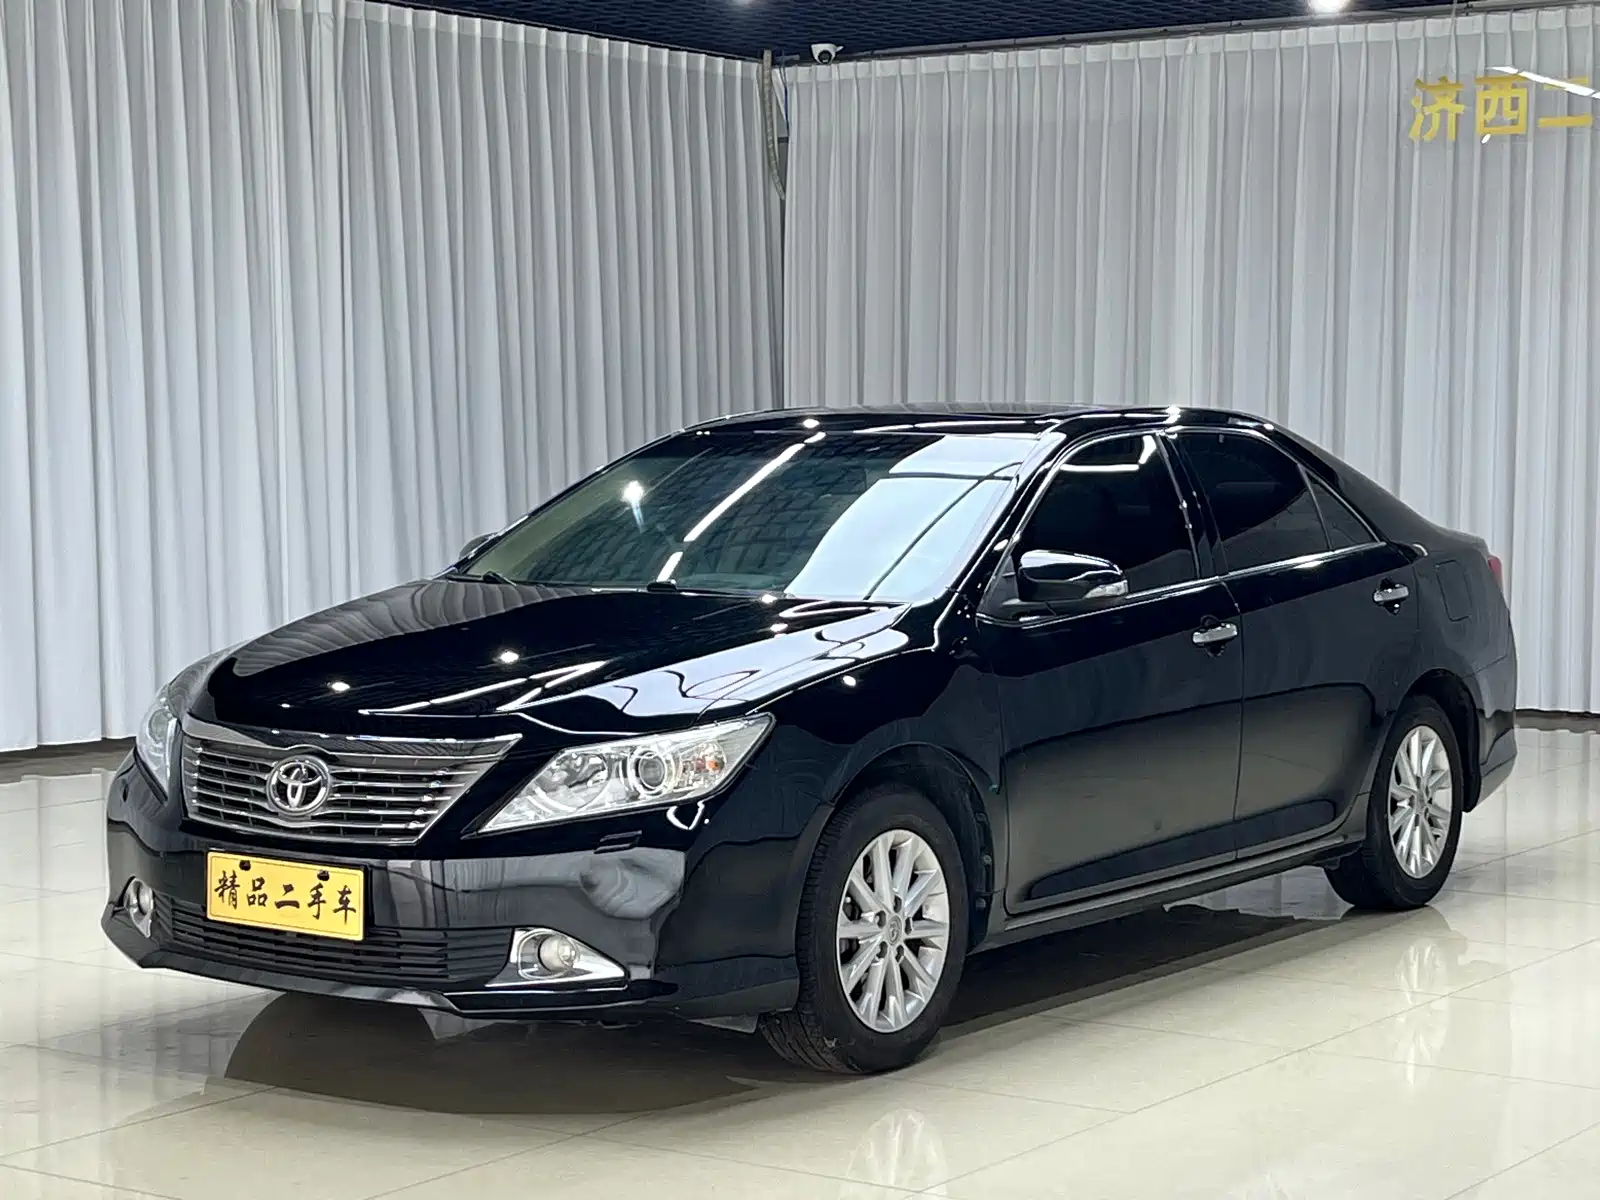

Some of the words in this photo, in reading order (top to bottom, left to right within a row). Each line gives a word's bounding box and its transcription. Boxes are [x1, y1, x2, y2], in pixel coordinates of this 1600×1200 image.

[1408, 75, 1593, 142] 济西二
[214, 869, 357, 925] 精品二手车
